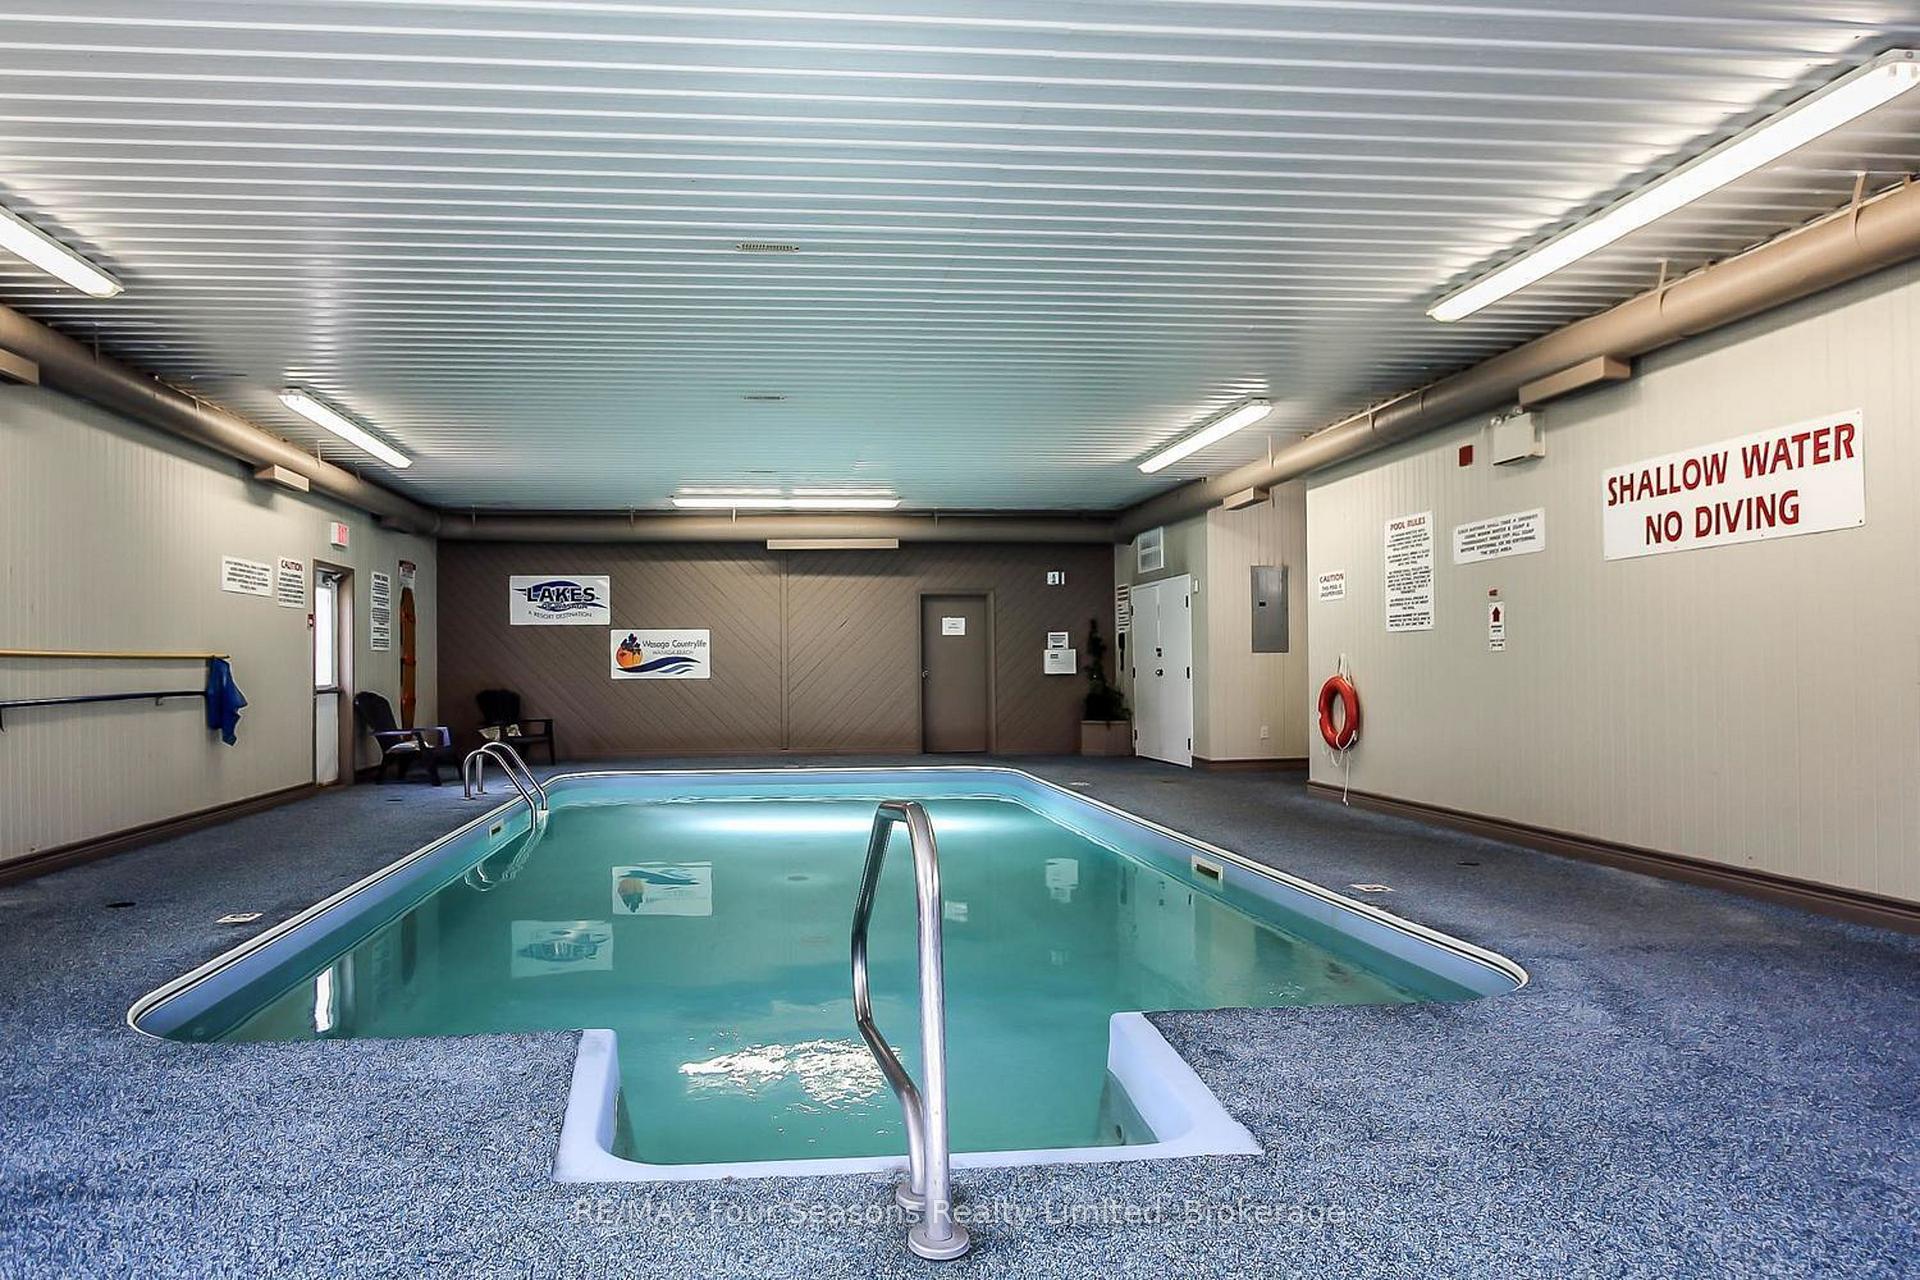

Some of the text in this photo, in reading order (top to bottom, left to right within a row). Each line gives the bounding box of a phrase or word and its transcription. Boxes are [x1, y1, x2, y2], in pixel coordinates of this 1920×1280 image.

[1607, 423, 1856, 507] SHALLOW WATER
[1645, 489, 1800, 545] NO DIVING
[1390, 521, 1405, 531] POOL
[281, 560, 303, 572] CAUTION
[1319, 573, 1344, 584] CAUTION
[526, 586, 596, 602] LAKES
[642, 639, 707, 649] Wasaga Countrylife
